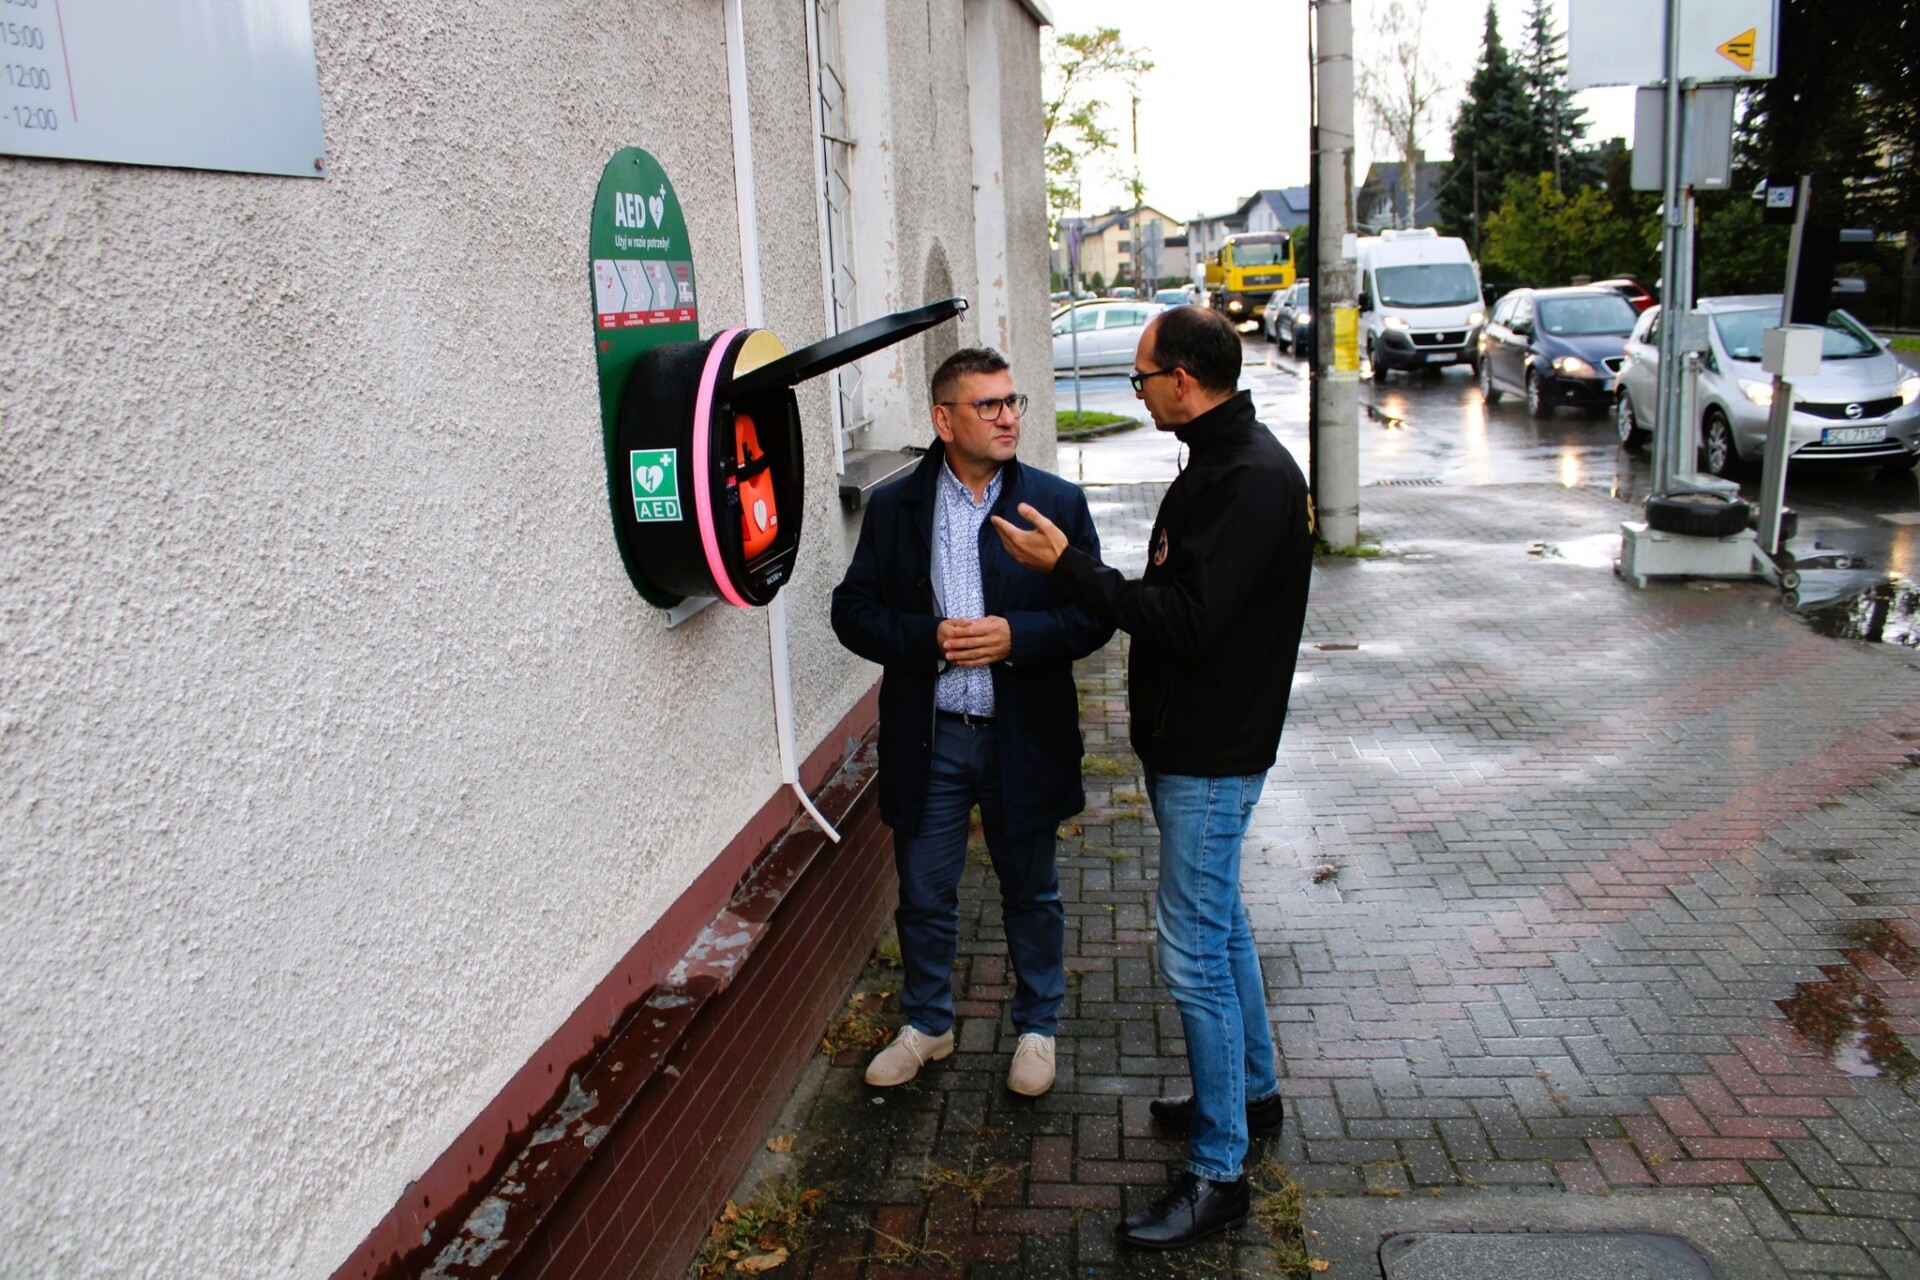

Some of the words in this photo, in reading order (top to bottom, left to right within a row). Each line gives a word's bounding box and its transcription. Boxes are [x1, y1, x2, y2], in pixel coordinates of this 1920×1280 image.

[0, 22, 44, 50] 15:00
[5, 64, 51, 91] 12:00
[13, 106, 58, 131] 12:00
[615, 192, 646, 229] AED
[627, 238, 633, 248] w
[634, 235, 647, 248] razie
[647, 236, 670, 252] potrzeby!
[640, 501, 677, 518] AED
